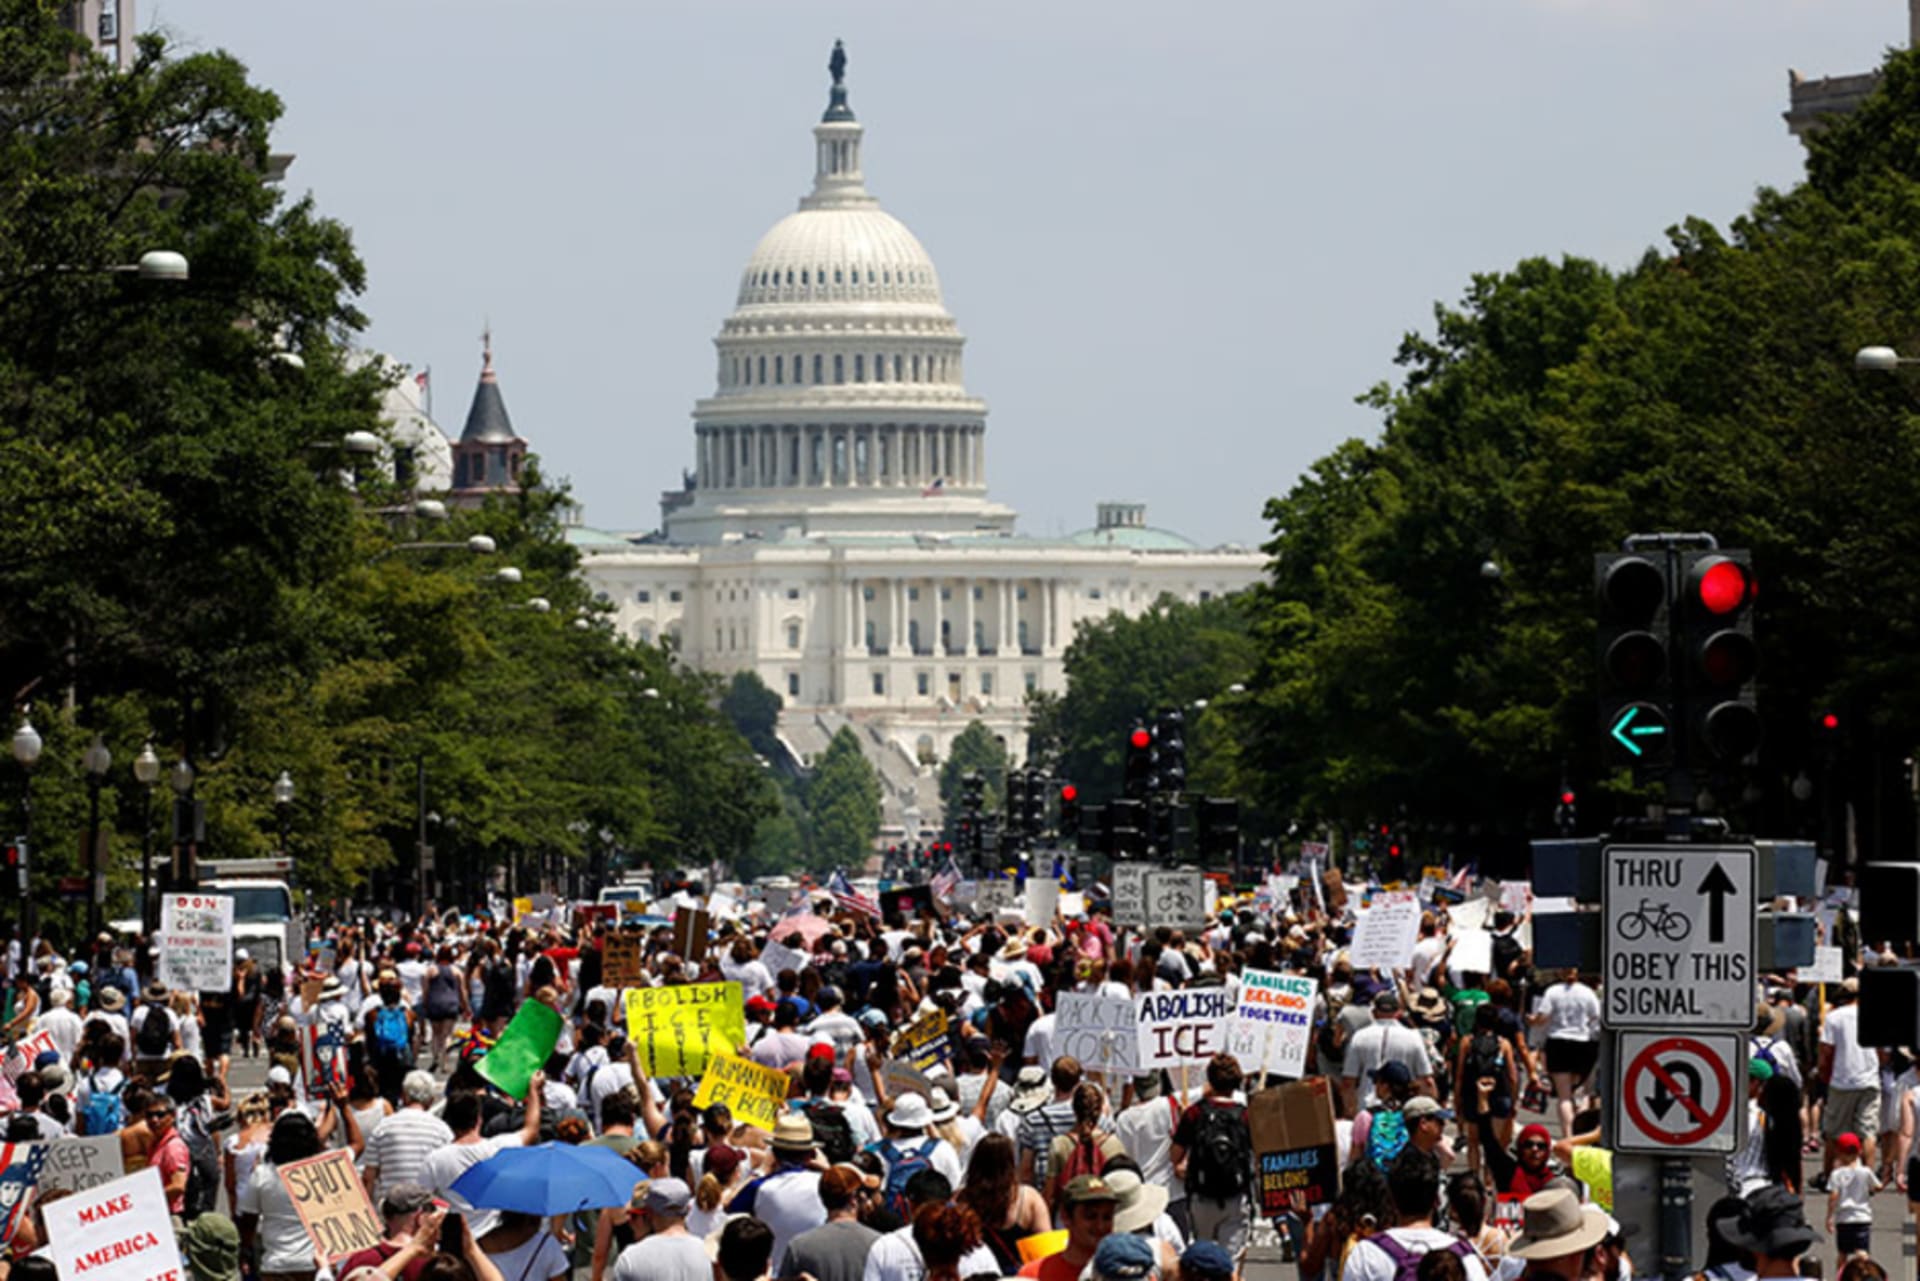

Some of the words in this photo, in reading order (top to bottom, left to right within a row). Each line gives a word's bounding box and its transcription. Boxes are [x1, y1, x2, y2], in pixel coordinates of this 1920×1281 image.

[1614, 858, 1683, 888] THRU
[176, 896, 217, 909] DON
[1612, 952, 1680, 980] OBEY
[1690, 952, 1747, 981] THIS
[628, 986, 728, 1010] ABOLISH
[1243, 972, 1311, 997] FAMILIES
[1058, 1000, 1104, 1027] PACK
[1139, 993, 1225, 1023] ABOLISH
[1239, 1005, 1307, 1026] TOGETHER
[1612, 987, 1703, 1015] SIGNAL
[1151, 1023, 1216, 1059] ICE
[45, 1142, 99, 1172] KEEP
[1262, 1149, 1319, 1173] FAMILIES
[287, 1157, 352, 1204] SHUT
[78, 1193, 133, 1227] MAKE
[311, 1208, 382, 1257] DOWN
[74, 1231, 160, 1275] AMERICA
